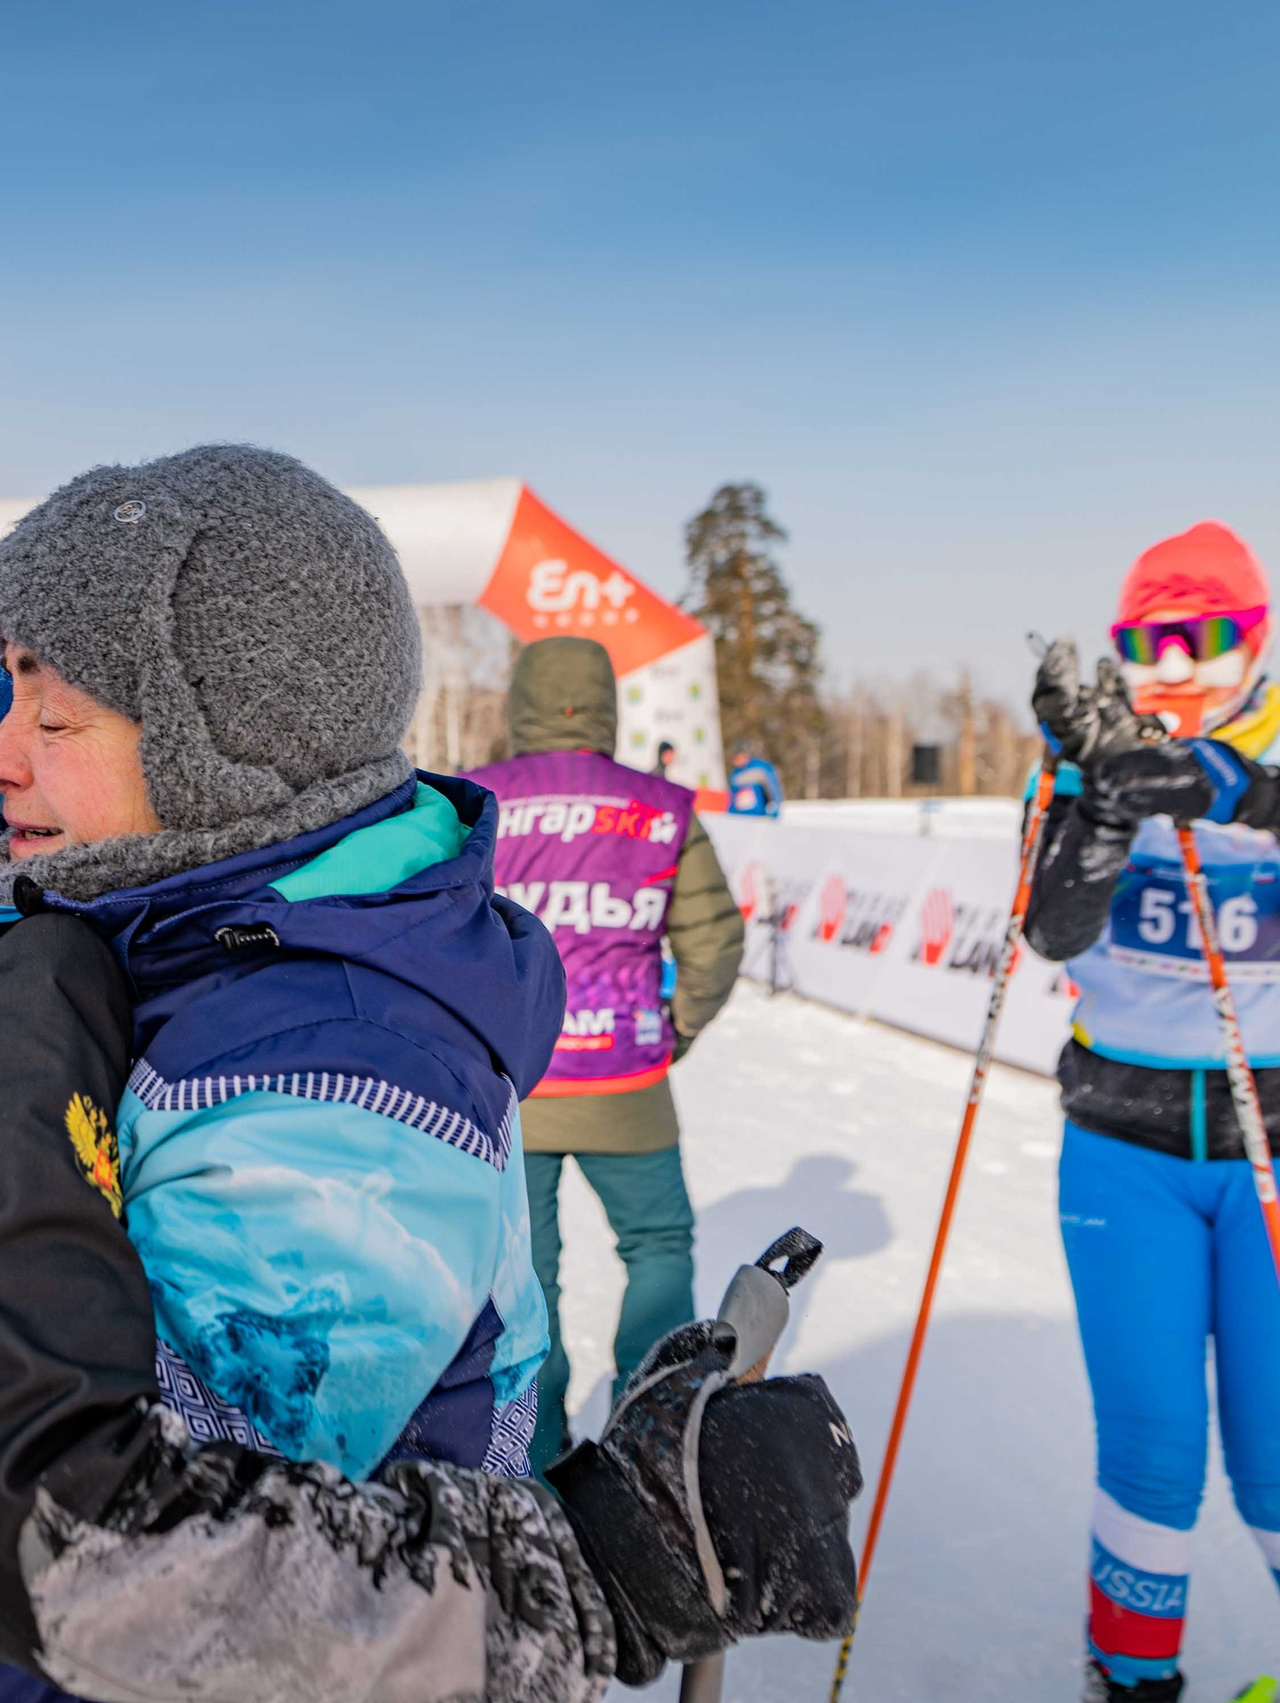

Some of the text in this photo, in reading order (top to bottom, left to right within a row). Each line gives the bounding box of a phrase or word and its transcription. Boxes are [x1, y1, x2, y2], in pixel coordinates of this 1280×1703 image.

[494, 881, 668, 934] УДЬЯ
[1137, 887, 1259, 954] 516
[828, 1421, 853, 1447] N
